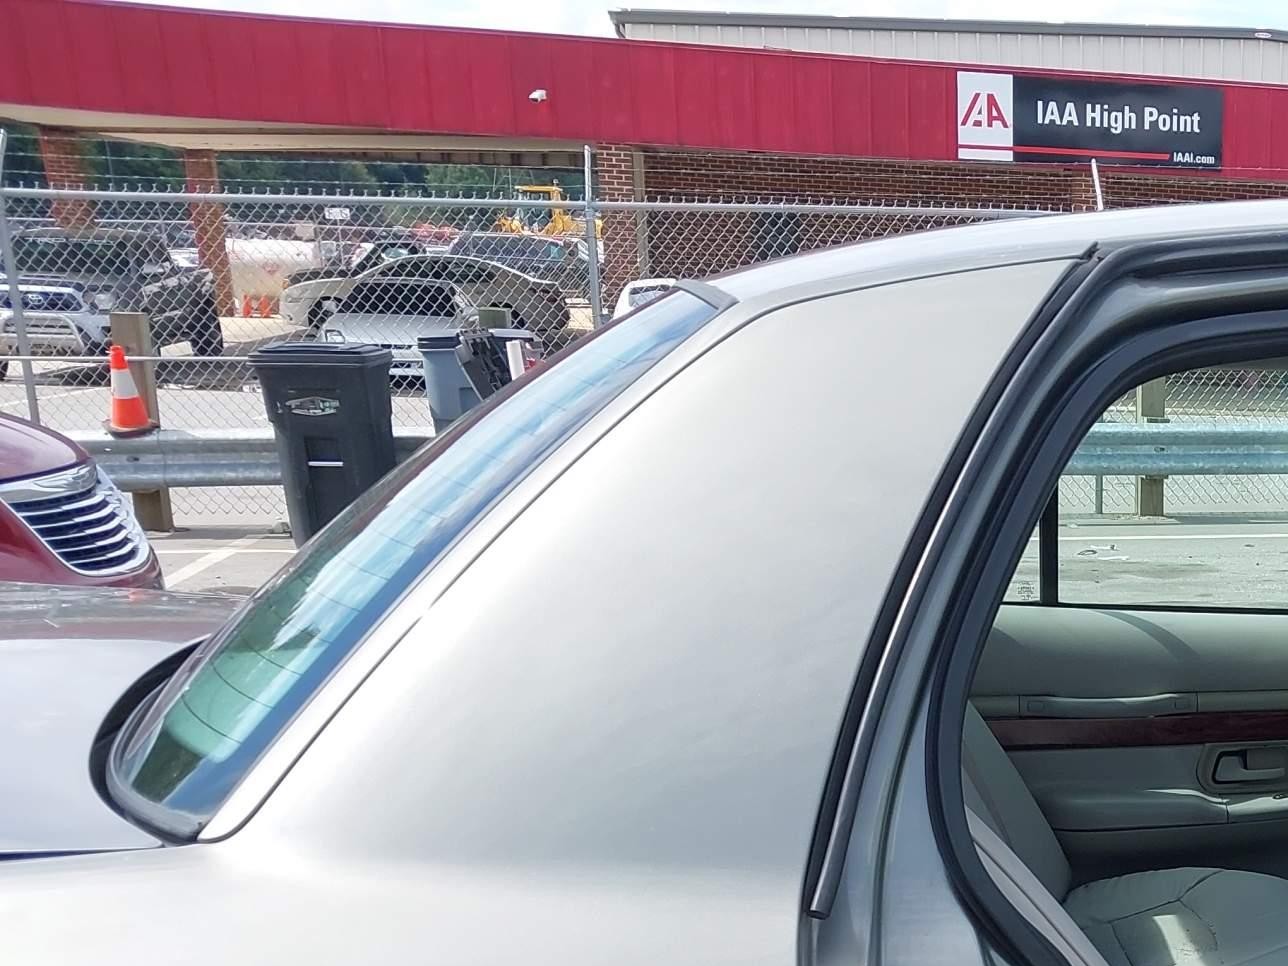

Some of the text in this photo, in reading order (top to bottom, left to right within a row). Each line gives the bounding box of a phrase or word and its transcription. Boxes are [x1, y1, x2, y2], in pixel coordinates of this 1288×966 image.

[1037, 100, 1201, 134] IAA High Point
[1173, 151, 1215, 165] IAAI.com
